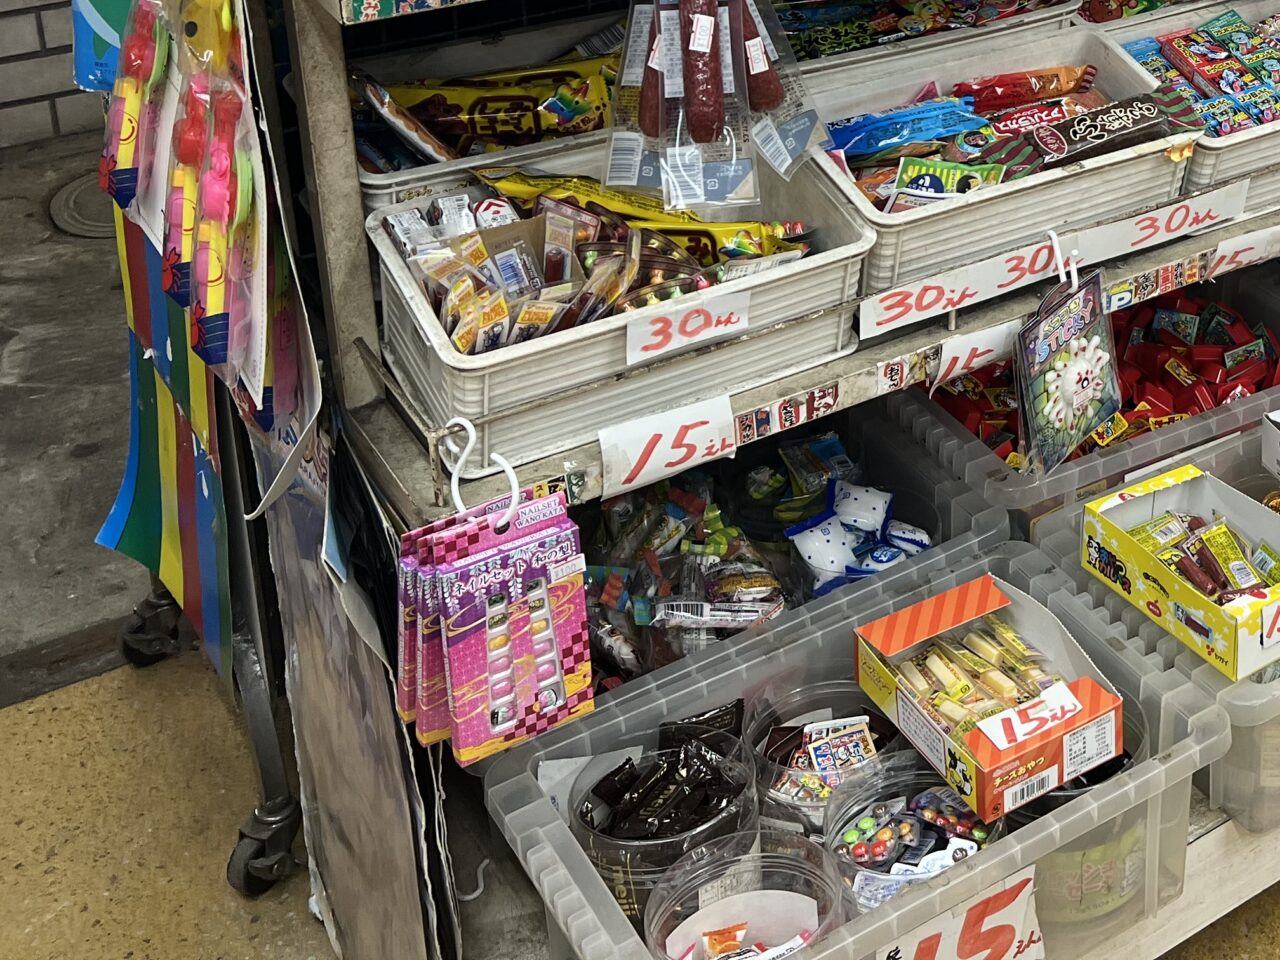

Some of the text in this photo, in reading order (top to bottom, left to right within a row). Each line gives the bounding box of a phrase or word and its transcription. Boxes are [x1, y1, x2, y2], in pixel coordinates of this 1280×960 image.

[1109, 291, 1133, 309] P
[1036, 301, 1094, 364] STICKY
[621, 420, 735, 486] 15えん
[519, 498, 560, 518] NAILSET
[541, 505, 566, 522] KATA
[452, 541, 573, 598] ネイルセット 和の型
[1000, 699, 1078, 745] 15えん
[992, 756, 1046, 786] チーズおやつ
